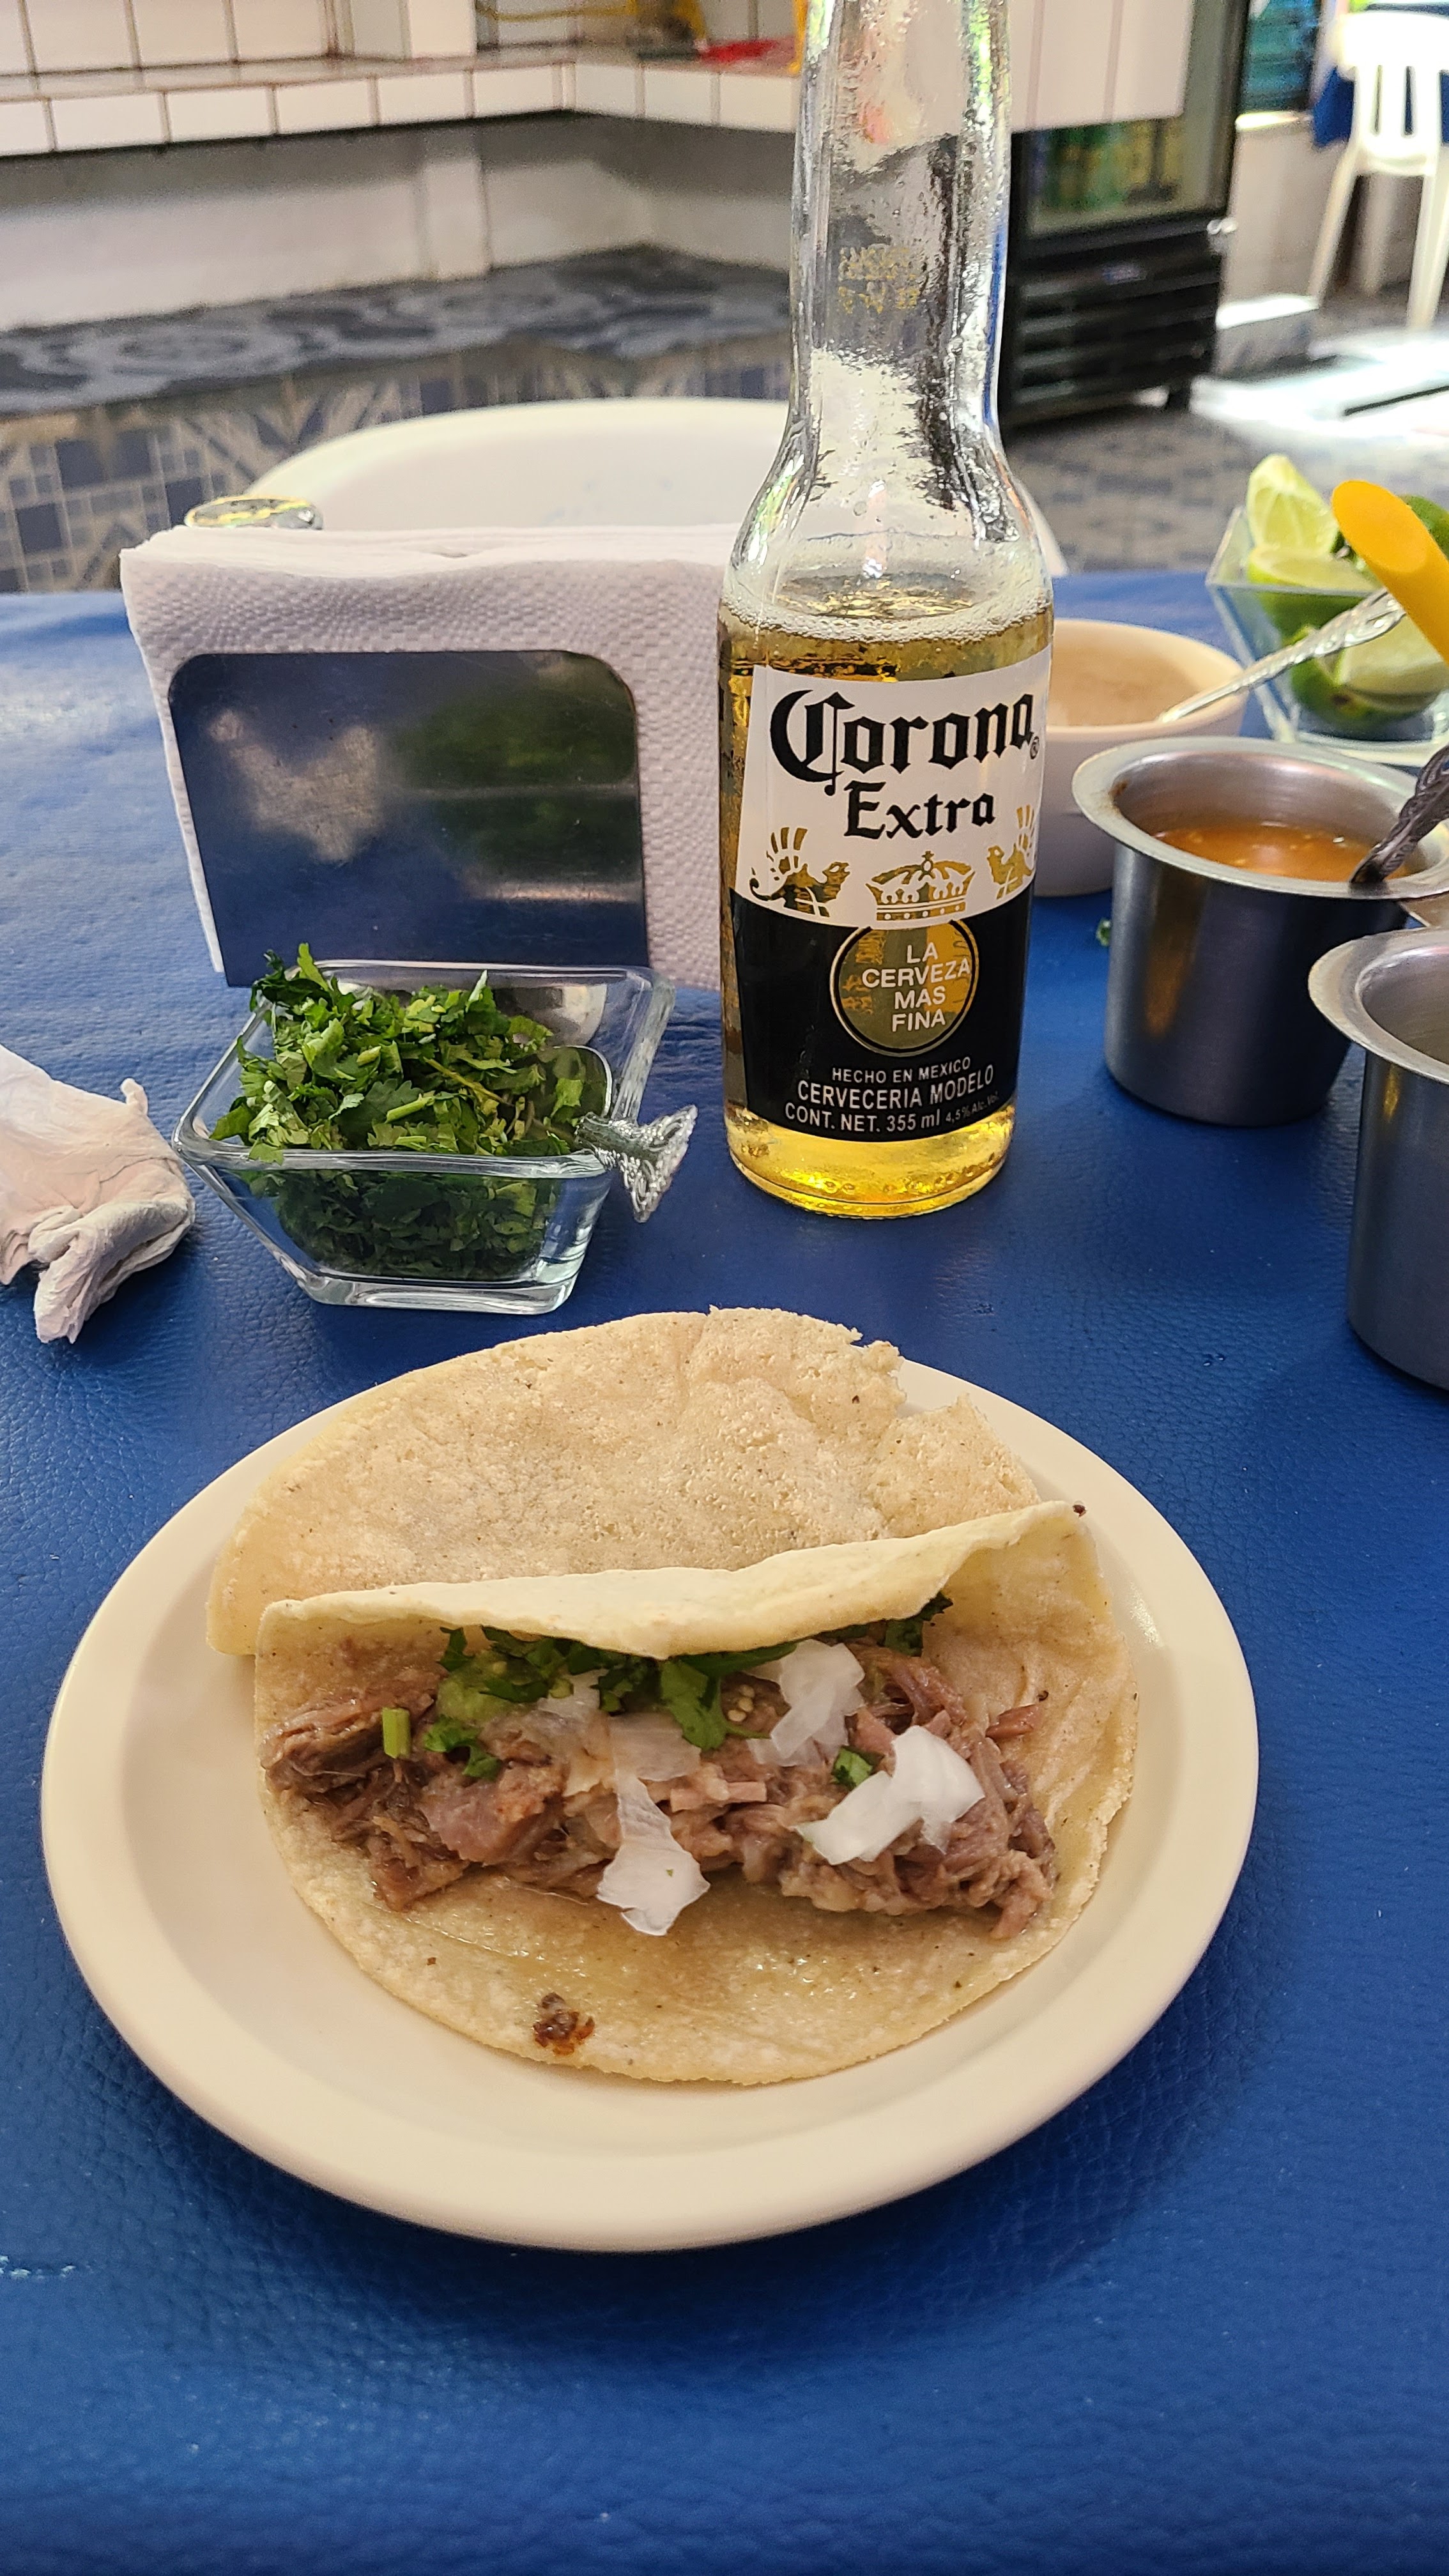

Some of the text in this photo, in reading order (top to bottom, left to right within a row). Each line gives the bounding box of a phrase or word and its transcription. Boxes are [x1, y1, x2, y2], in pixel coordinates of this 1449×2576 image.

[770, 689, 1034, 796] Corona
[843, 780, 995, 840] Extra
[907, 942, 938, 963] LA
[862, 958, 971, 988] CERVEZA
[894, 986, 946, 1009] MAS
[892, 1008, 946, 1032] FINA
[832, 1056, 971, 1084] HECHO EN MEXICO
[797, 1064, 994, 1110] CERVECERIA MODELO
[785, 1101, 836, 1130] CONT.
[841, 1113, 880, 1132] NET.
[886, 1113, 917, 1132] 355
[921, 1108, 940, 1128] ml
